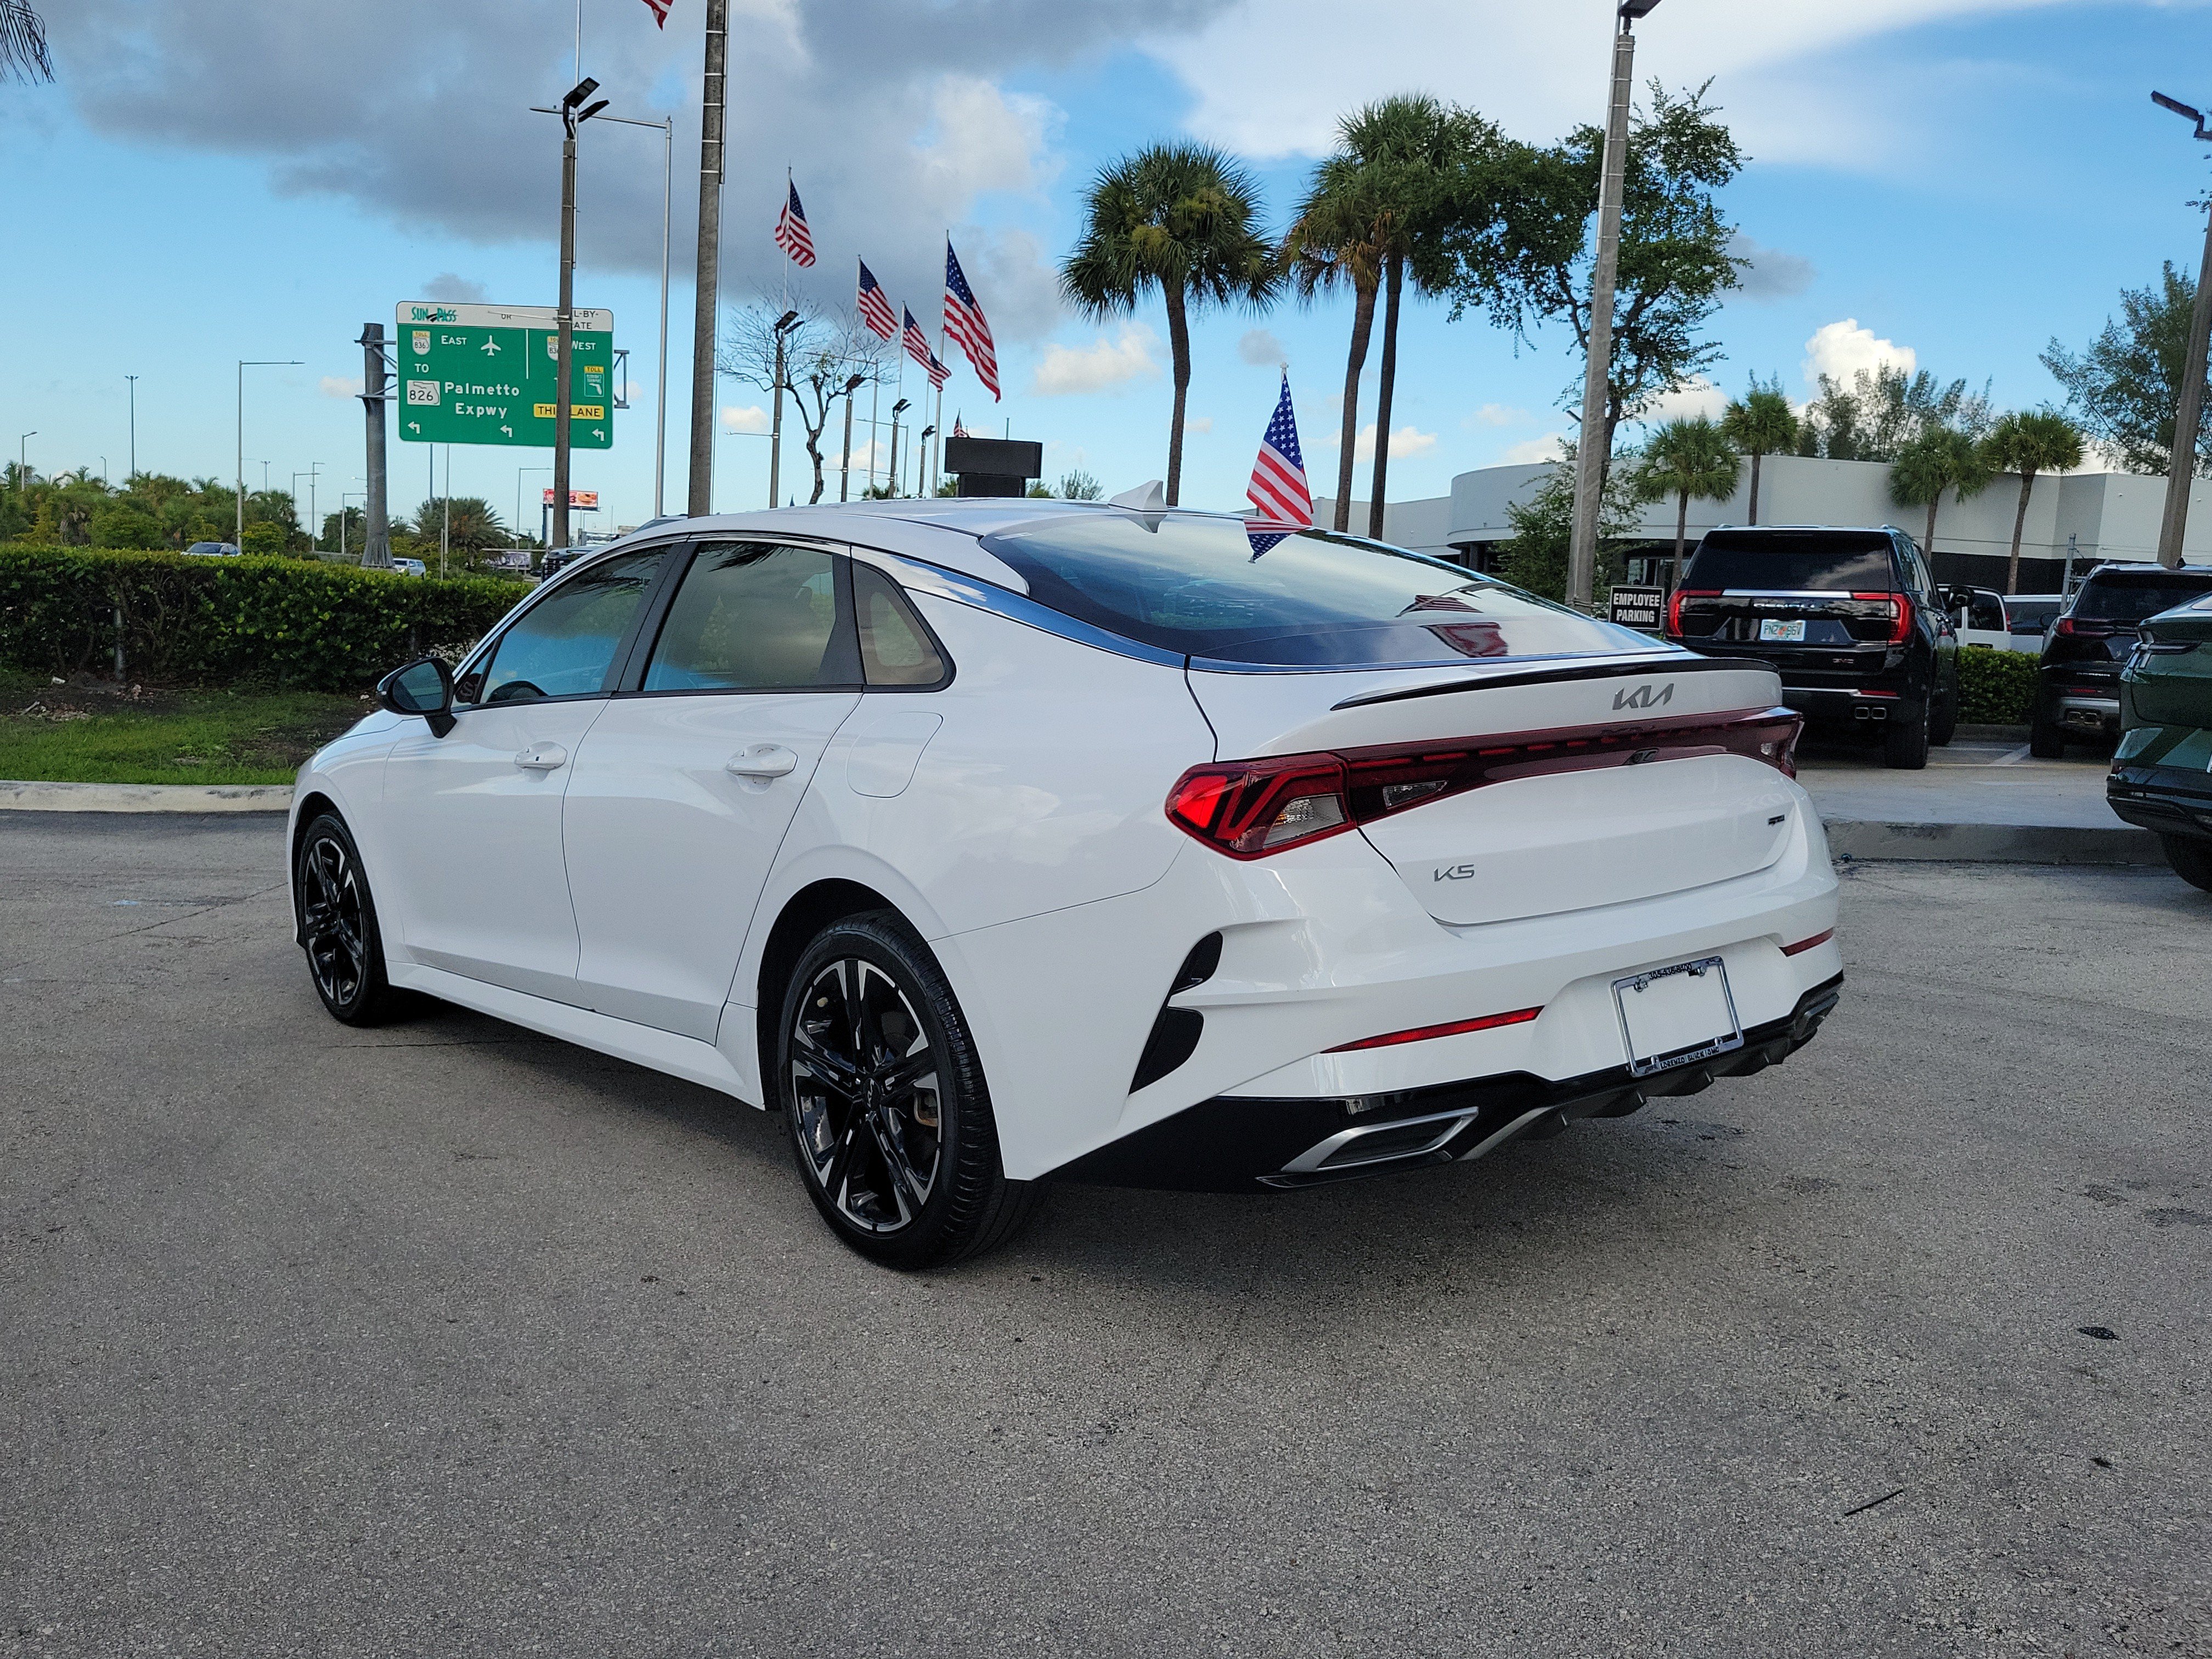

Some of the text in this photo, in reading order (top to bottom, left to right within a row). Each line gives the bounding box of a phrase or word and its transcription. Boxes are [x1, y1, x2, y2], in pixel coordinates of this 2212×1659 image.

[441, 335, 467, 345] EAST
[414, 363, 430, 373] TO
[409, 390, 433, 401] 826
[444, 381, 520, 397] Palmetto
[455, 402, 507, 419] Expwy
[538, 406, 556, 415] THI
[1613, 592, 1661, 607] EMPLOYEE
[1616, 609, 1655, 623] PARKING
[1434, 864, 1475, 882] K5
[1660, 1057, 1685, 1069] LORENZO
[1687, 1051, 1705, 1062] BUICK
